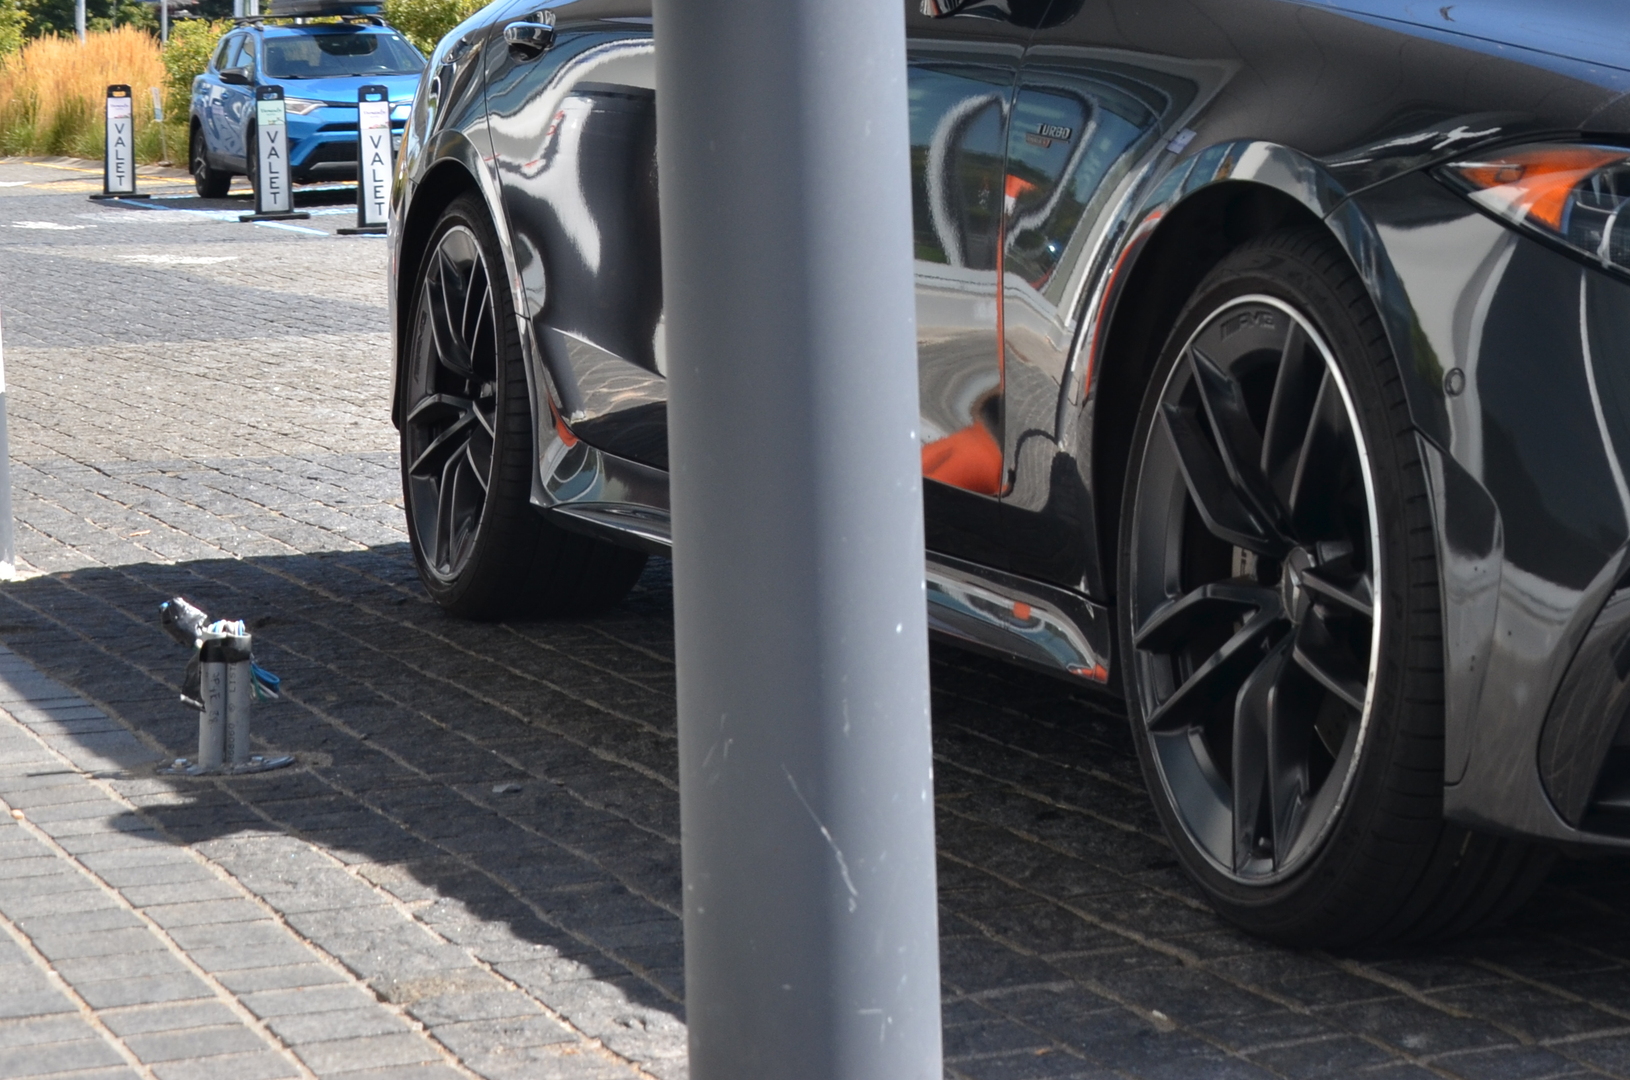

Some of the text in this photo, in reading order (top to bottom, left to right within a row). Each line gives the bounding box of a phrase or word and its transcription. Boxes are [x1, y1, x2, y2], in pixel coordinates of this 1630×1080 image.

[114, 123, 126, 186] VALET
[1036, 123, 1071, 139] TURBO
[266, 130, 281, 205] VALET
[369, 135, 386, 216] VALET
